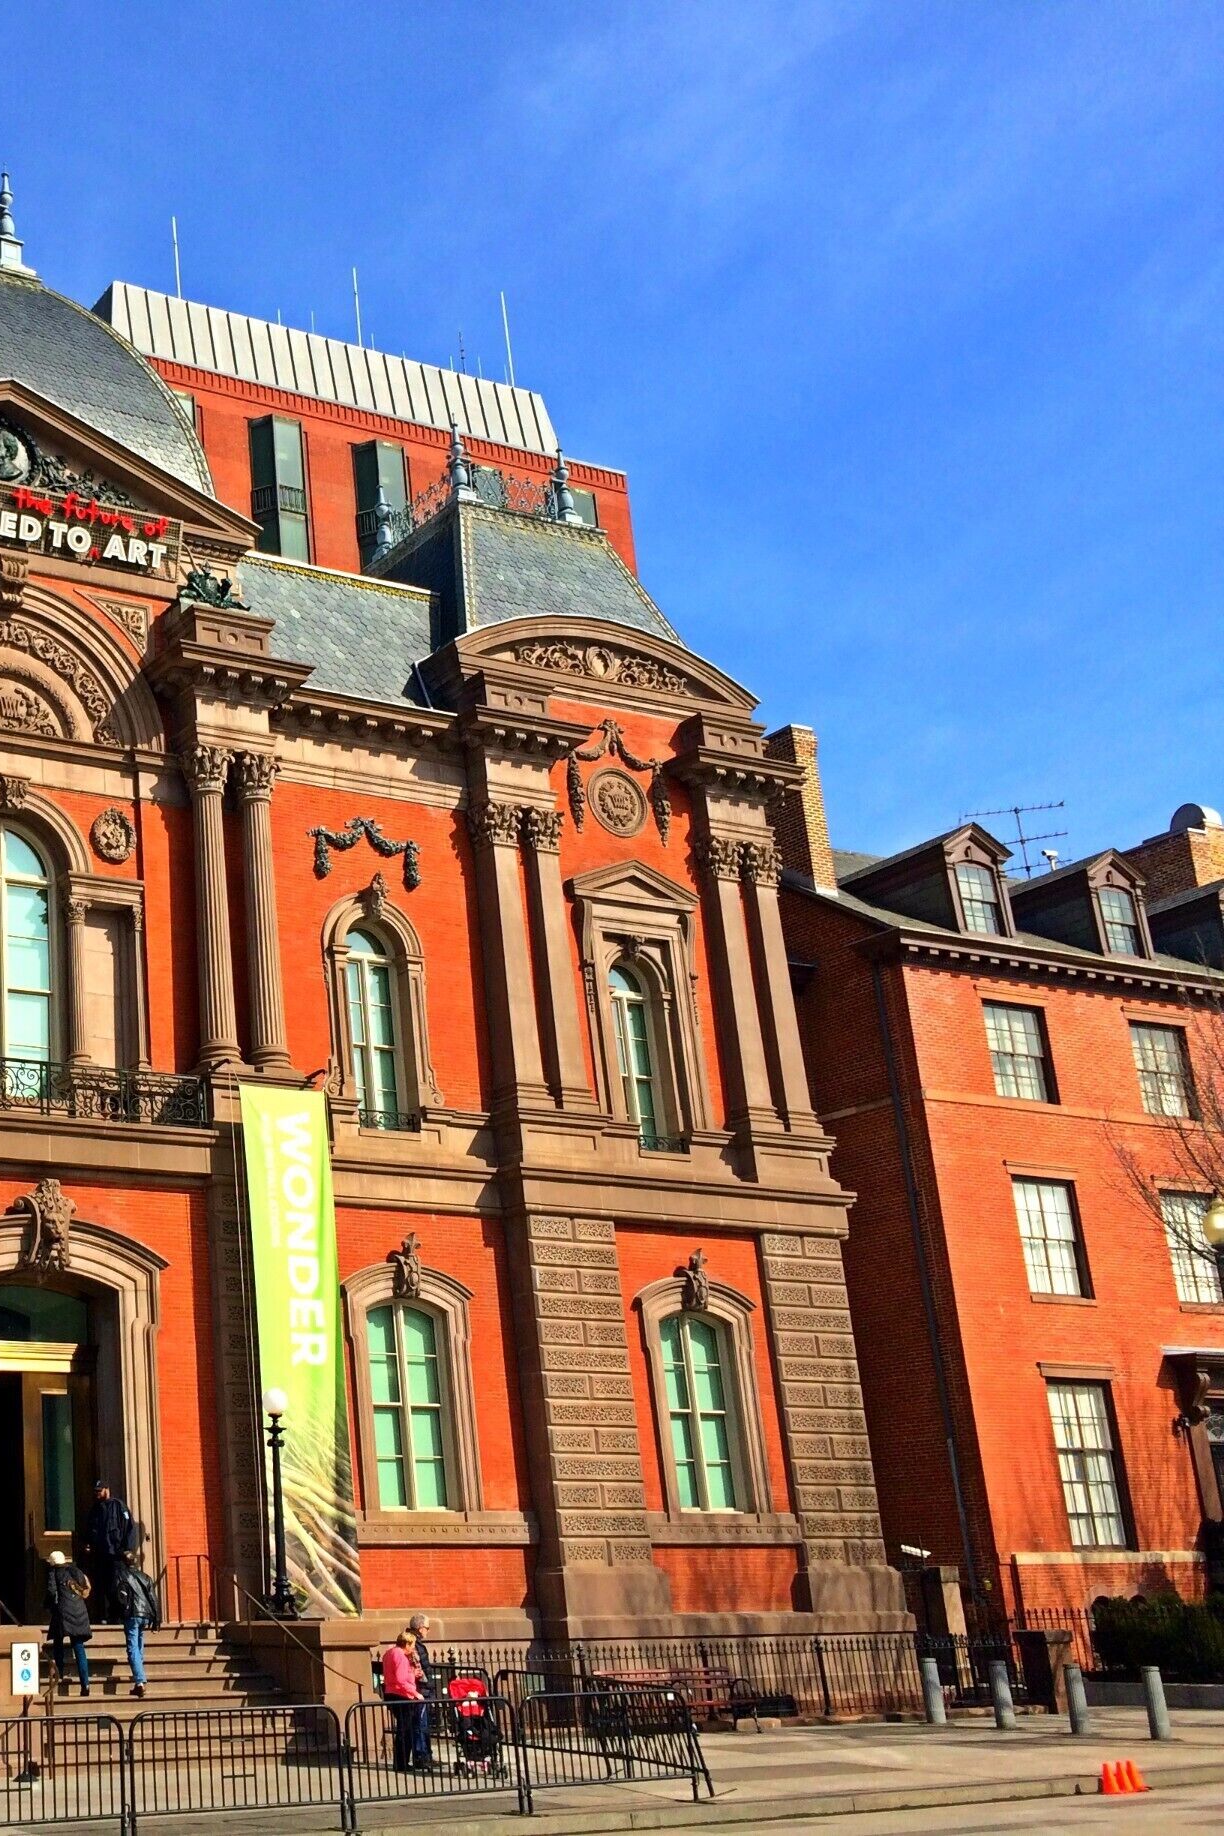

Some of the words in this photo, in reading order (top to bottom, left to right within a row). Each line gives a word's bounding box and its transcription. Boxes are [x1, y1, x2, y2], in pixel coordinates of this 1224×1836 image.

[11, 486, 54, 516] the
[63, 491, 135, 533] future
[143, 516, 169, 537] of
[49, 521, 92, 553] TO
[103, 534, 167, 569] ART
[276, 1111, 328, 1368] WONDER
